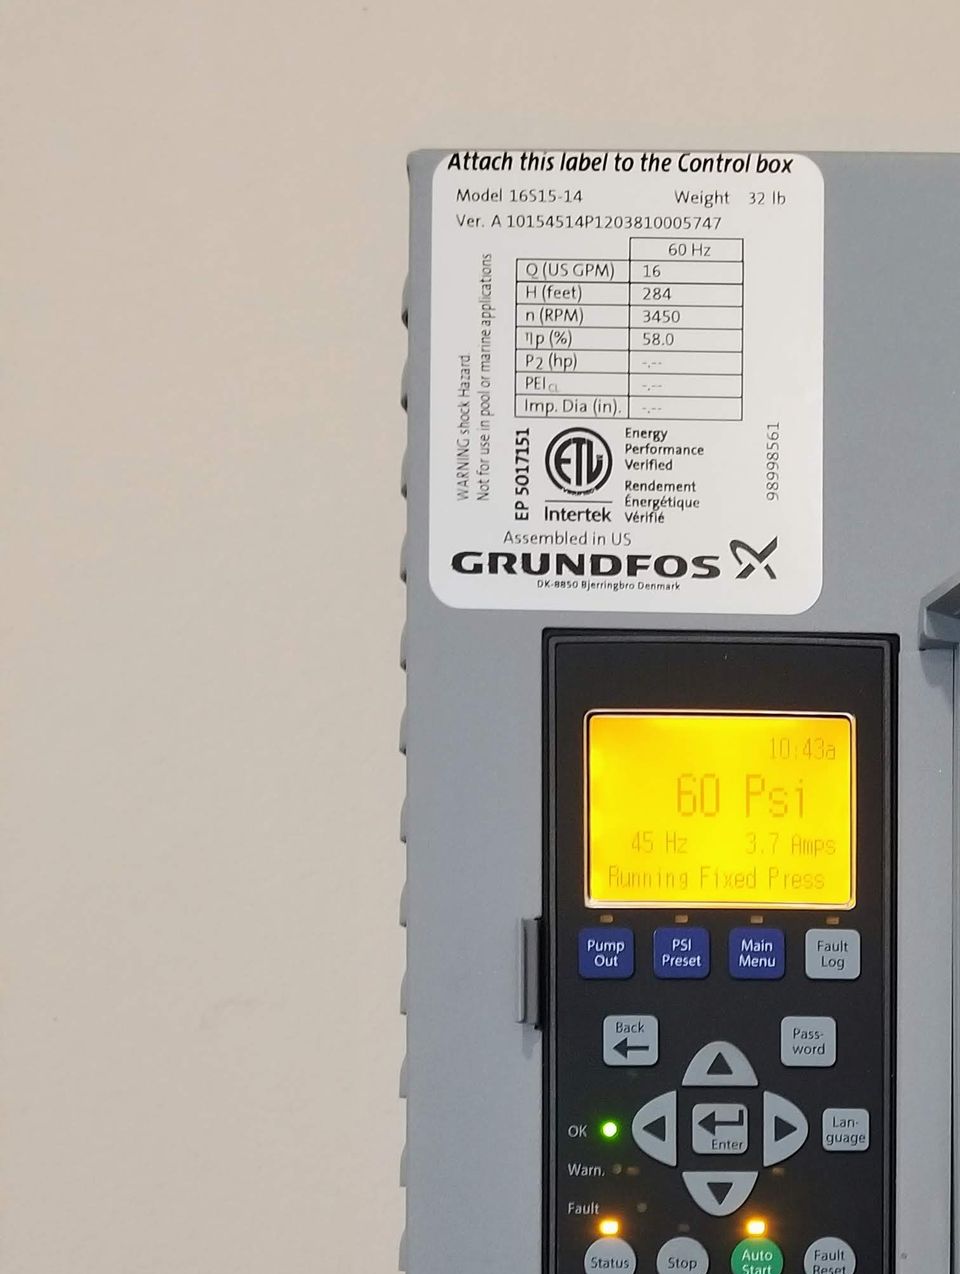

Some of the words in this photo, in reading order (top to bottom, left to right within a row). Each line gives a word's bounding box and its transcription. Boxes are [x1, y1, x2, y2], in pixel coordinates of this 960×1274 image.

[447, 152, 513, 171] Attach
[520, 152, 554, 171] this
[560, 152, 608, 172] label
[614, 154, 634, 172] to
[641, 153, 672, 172] the
[678, 153, 751, 173] Control
[756, 153, 794, 174] box
[456, 188, 503, 203] Model
[509, 189, 583, 203] 16S15-14
[674, 190, 730, 208] Weight
[749, 191, 765, 205] 32
[772, 190, 786, 205] lb
[456, 214, 485, 228] Ver.
[491, 214, 501, 228] A
[507, 215, 722, 230] 10154514P1203810005747
[668, 242, 687, 256] 60
[692, 243, 711, 257] Hz
[526, 262, 538, 279] Q
[542, 261, 568, 280] (US
[573, 262, 615, 280] GPM)
[643, 264, 661, 278] 16
[478, 253, 496, 327] applications
[526, 285, 537, 299] H
[542, 284, 582, 303] (feet)
[643, 287, 672, 301] 284
[526, 310, 535, 321] n
[540, 307, 584, 326] (RPM)
[643, 310, 681, 324] 3450
[549, 330, 573, 349] (%)
[643, 332, 674, 346] 58.0
[477, 329, 490, 371] marine
[549, 352, 577, 372] (hp)
[480, 374, 490, 388] or
[476, 391, 495, 416] pool
[524, 399, 557, 417] Imp.
[562, 399, 588, 413] Dia
[593, 398, 622, 416] (in).
[457, 402, 470, 435] shock
[477, 421, 490, 433] in
[624, 428, 668, 442] Energy
[480, 433, 490, 454] use
[624, 444, 705, 459] Performance
[476, 454, 489, 474] for
[515, 428, 529, 495] 5017151
[624, 459, 673, 472] Verified
[766, 421, 780, 502] 98998561
[456, 438, 470, 501] WARNING
[476, 477, 490, 501] Not
[624, 480, 696, 493] Rendement
[514, 499, 529, 521] EP
[624, 494, 701, 511] Énergétique
[544, 506, 612, 522] Intertek
[624, 510, 665, 525] Vérifié
[503, 531, 588, 547] Assembled
[592, 532, 606, 547] in
[611, 532, 632, 547] US
[451, 551, 721, 580] GRUNDFOS
[537, 579, 579, 590] DK-8850
[581, 580, 635, 592] Bjerringbro
[637, 582, 681, 592] Denmark
[769, 736, 836, 760] 10:43a
[676, 772, 720, 818] 60
[744, 773, 804, 818] Psi
[631, 831, 654, 854] 45
[665, 832, 688, 854] Hz
[745, 832, 780, 855] 3.7
[791, 834, 836, 856] Amps
[608, 864, 689, 889] Running
[700, 866, 757, 890] Fixed
[768, 867, 825, 890] Press
[587, 940, 625, 952] Pump
[672, 939, 692, 951] PSI
[741, 939, 773, 951] Main
[817, 940, 848, 952] Fault
[594, 954, 619, 967] Out
[662, 954, 702, 966] Preset
[739, 955, 776, 967] Menu
[821, 956, 846, 970] Log
[615, 1021, 645, 1033] Back
[793, 1027, 824, 1040] Pass-
[792, 1043, 826, 1055] word
[832, 1117, 859, 1128] Lan-
[567, 1125, 588, 1138] OK
[711, 1139, 743, 1151] Enter
[826, 1134, 866, 1146] guage
[567, 1164, 605, 1177] Warn.
[567, 1202, 599, 1215] Fault
[590, 1256, 630, 1269] Status
[742, 1250, 773, 1262] Auto
[814, 1250, 845, 1261] Fault
[667, 1257, 697, 1272] Stop
